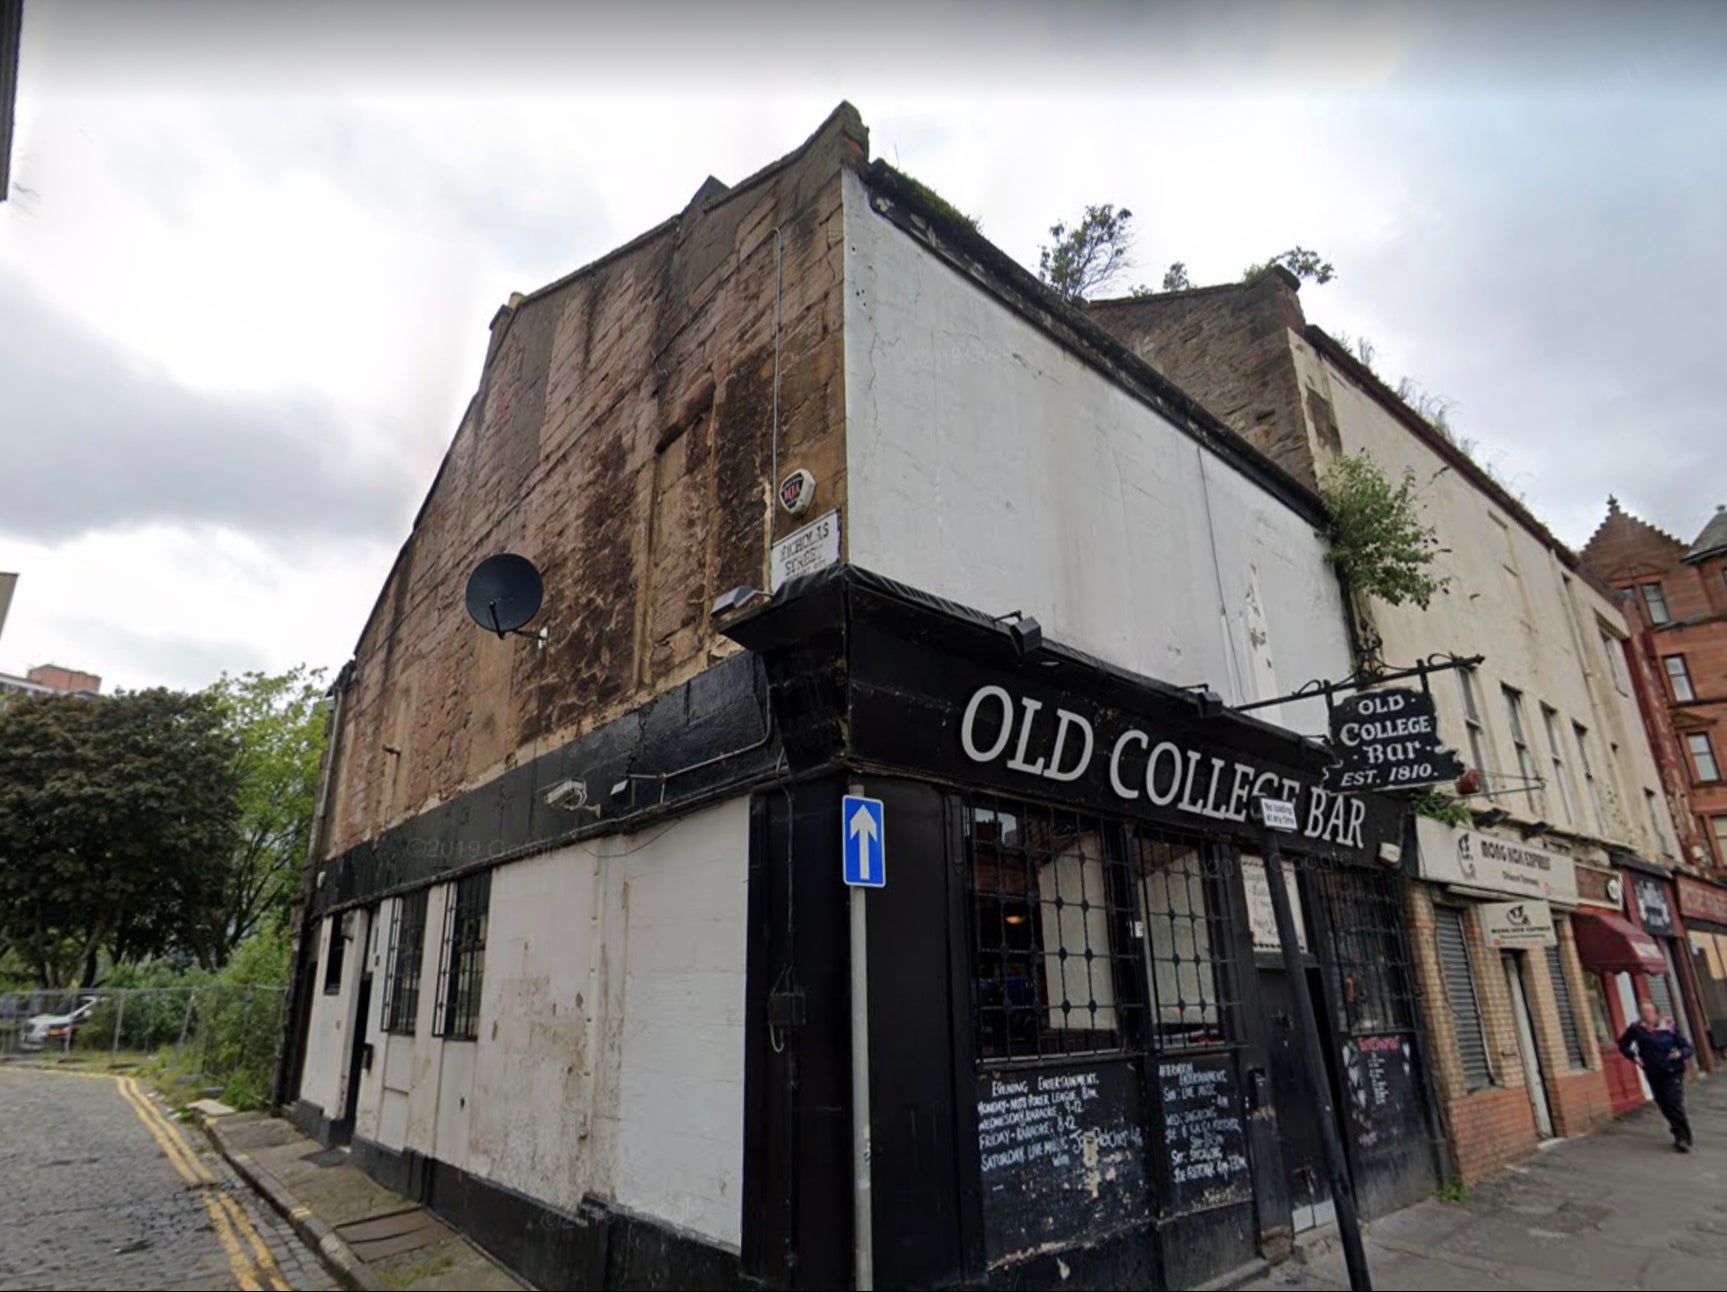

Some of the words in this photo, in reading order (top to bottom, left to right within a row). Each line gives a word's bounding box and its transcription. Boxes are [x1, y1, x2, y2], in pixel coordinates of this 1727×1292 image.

[1358, 695, 1405, 715] OLD
[1340, 716, 1432, 746] COLLEGE
[961, 685, 1094, 781] OLD
[1304, 786, 1366, 849] BAR
[1340, 770, 1381, 786] EST.
